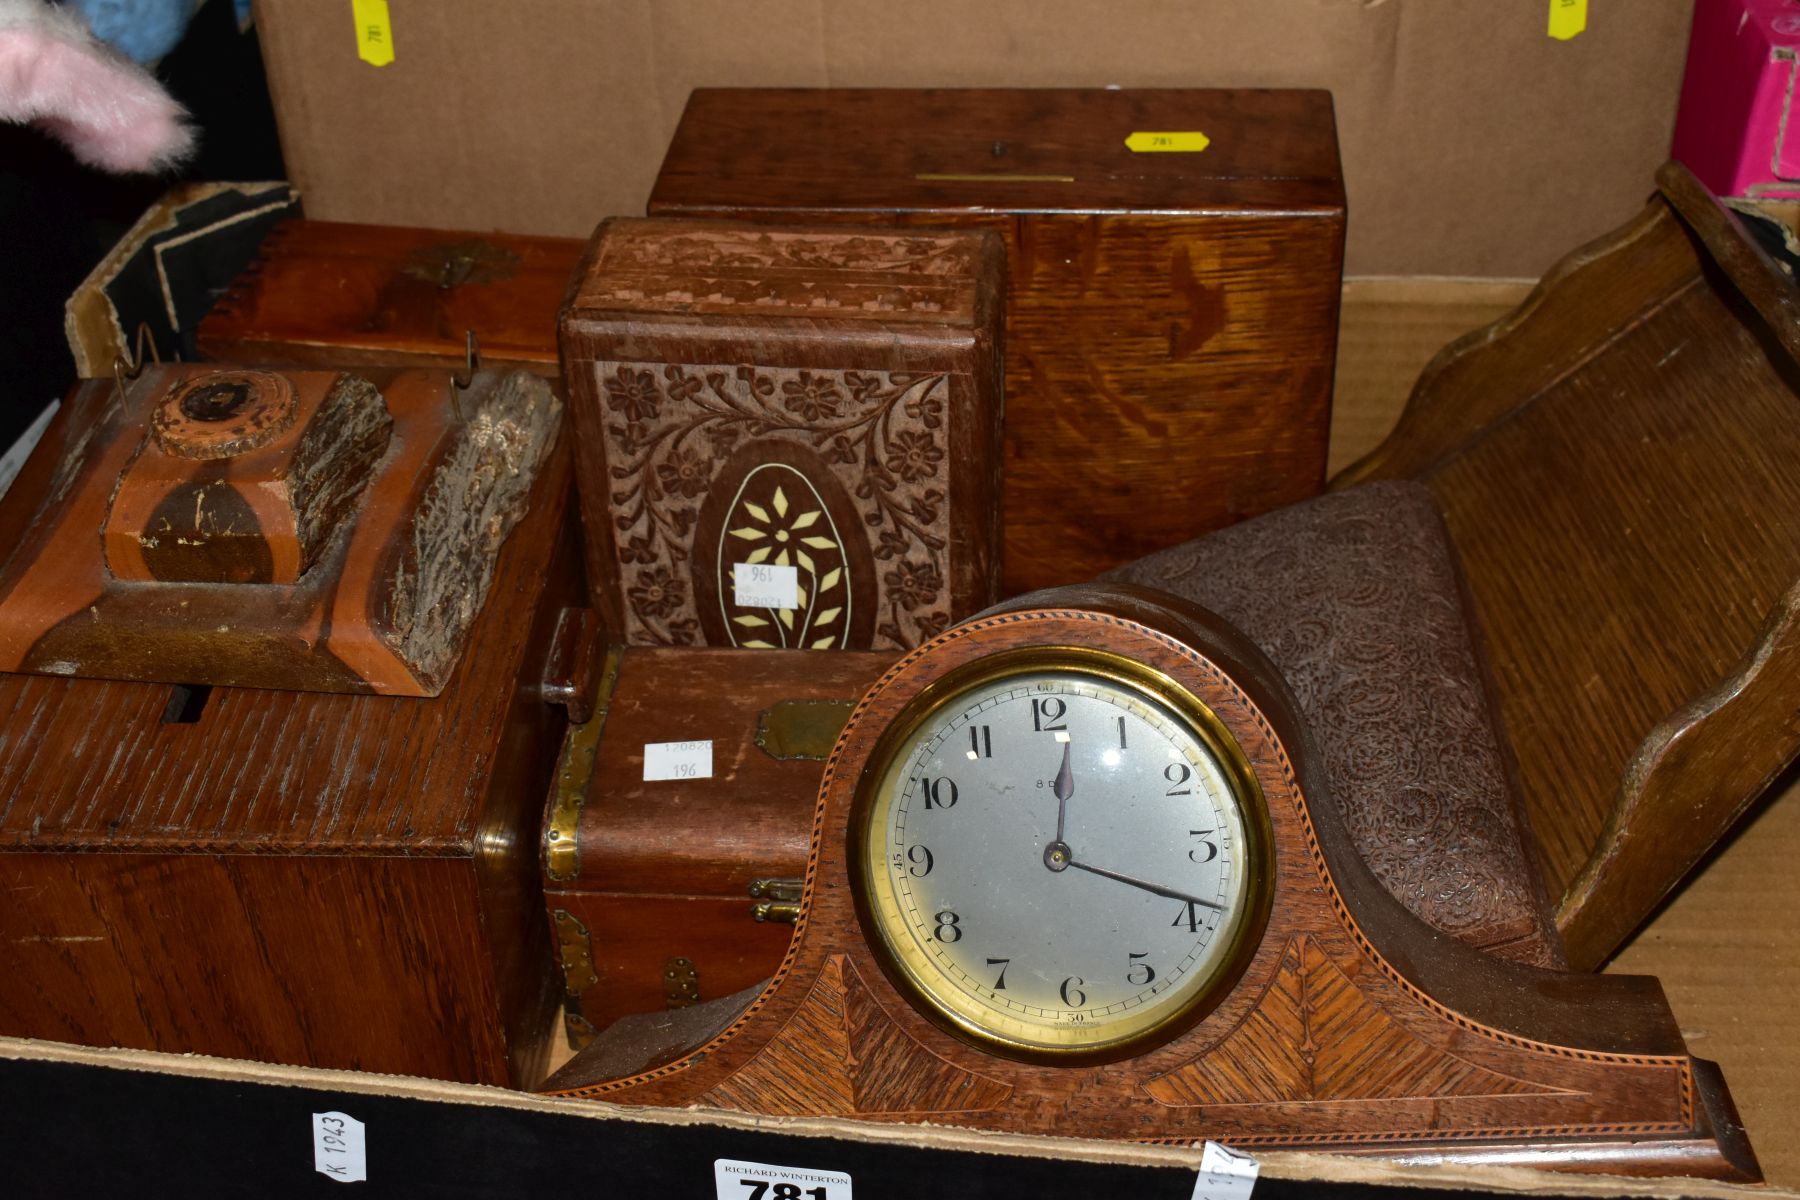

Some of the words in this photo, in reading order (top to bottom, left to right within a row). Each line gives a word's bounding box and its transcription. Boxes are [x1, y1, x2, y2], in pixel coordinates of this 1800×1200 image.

[1031, 697, 1067, 731] 12
[968, 724, 992, 758] 11
[1117, 716, 1127, 749] 1
[673, 762, 697, 778] 196
[1163, 762, 1191, 797] 2
[921, 776, 959, 810] 10
[893, 853, 903, 870] 45
[908, 844, 934, 877] 9
[1189, 830, 1217, 863] 3
[933, 911, 962, 943] 8
[1171, 899, 1203, 932] 4
[986, 957, 1010, 990] 7
[1127, 951, 1156, 986] 5
[1059, 976, 1086, 1008] 6
[1067, 1013, 1084, 1023] 30
[321, 1116, 346, 1153] 1943
[326, 1163, 347, 1175] K
[725, 1165, 777, 1177] RICHARD
[781, 1172, 848, 1185] WINTERTON
[740, 1179, 827, 1200] 781
